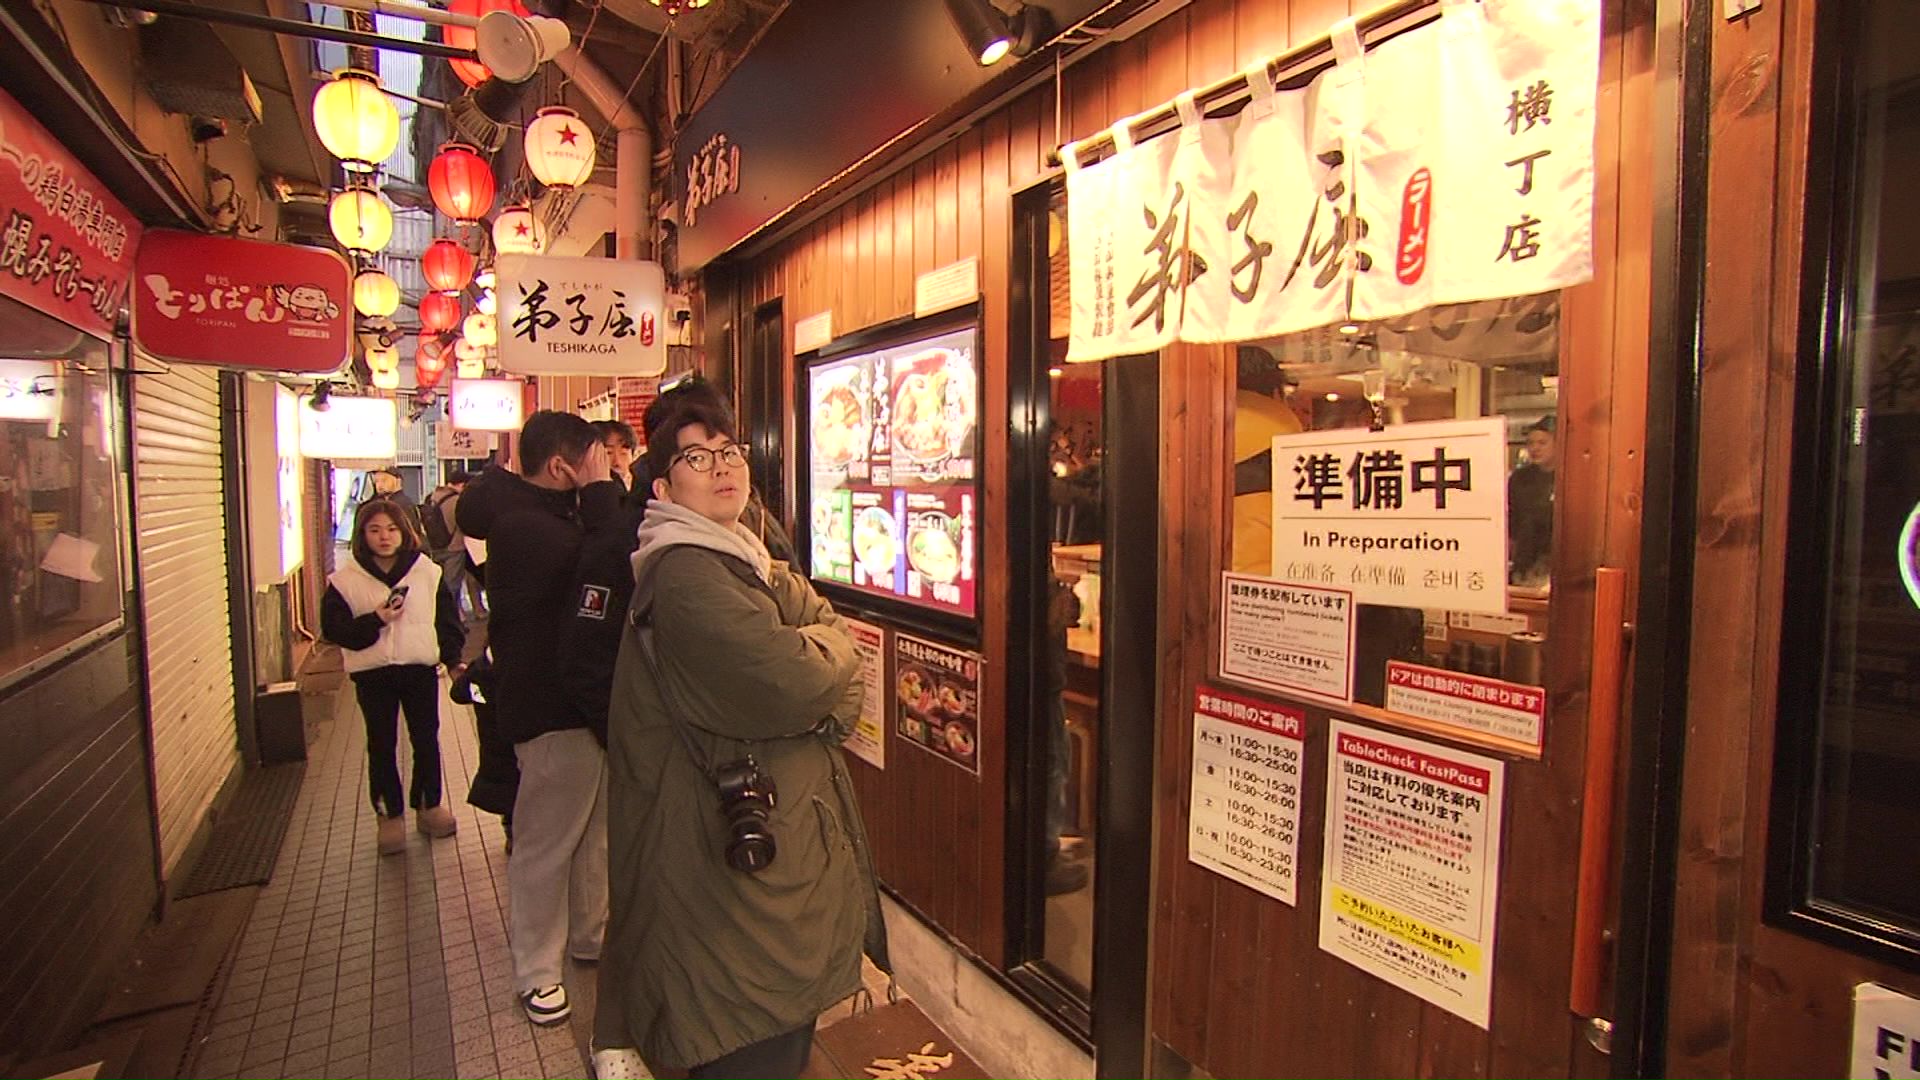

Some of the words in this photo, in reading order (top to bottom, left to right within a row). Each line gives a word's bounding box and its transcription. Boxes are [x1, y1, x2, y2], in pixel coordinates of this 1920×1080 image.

[1496, 80, 1554, 262] 横丁店
[1126, 150, 1373, 334] 弟子屈
[1400, 168, 1431, 280] ラーメン
[196, 318, 237, 329] TORIPAN
[512, 279, 637, 343] 弟子屈
[546, 342, 617, 354] TESHIKAGA
[1293, 446, 1471, 511] 準備中
[1303, 531, 1320, 548] In
[1328, 531, 1460, 554] Preparation
[1342, 738, 1415, 769] TableCheck
[1420, 761, 1483, 788] FastPass
[1343, 760, 1480, 813] 当店は有料の優先案内
